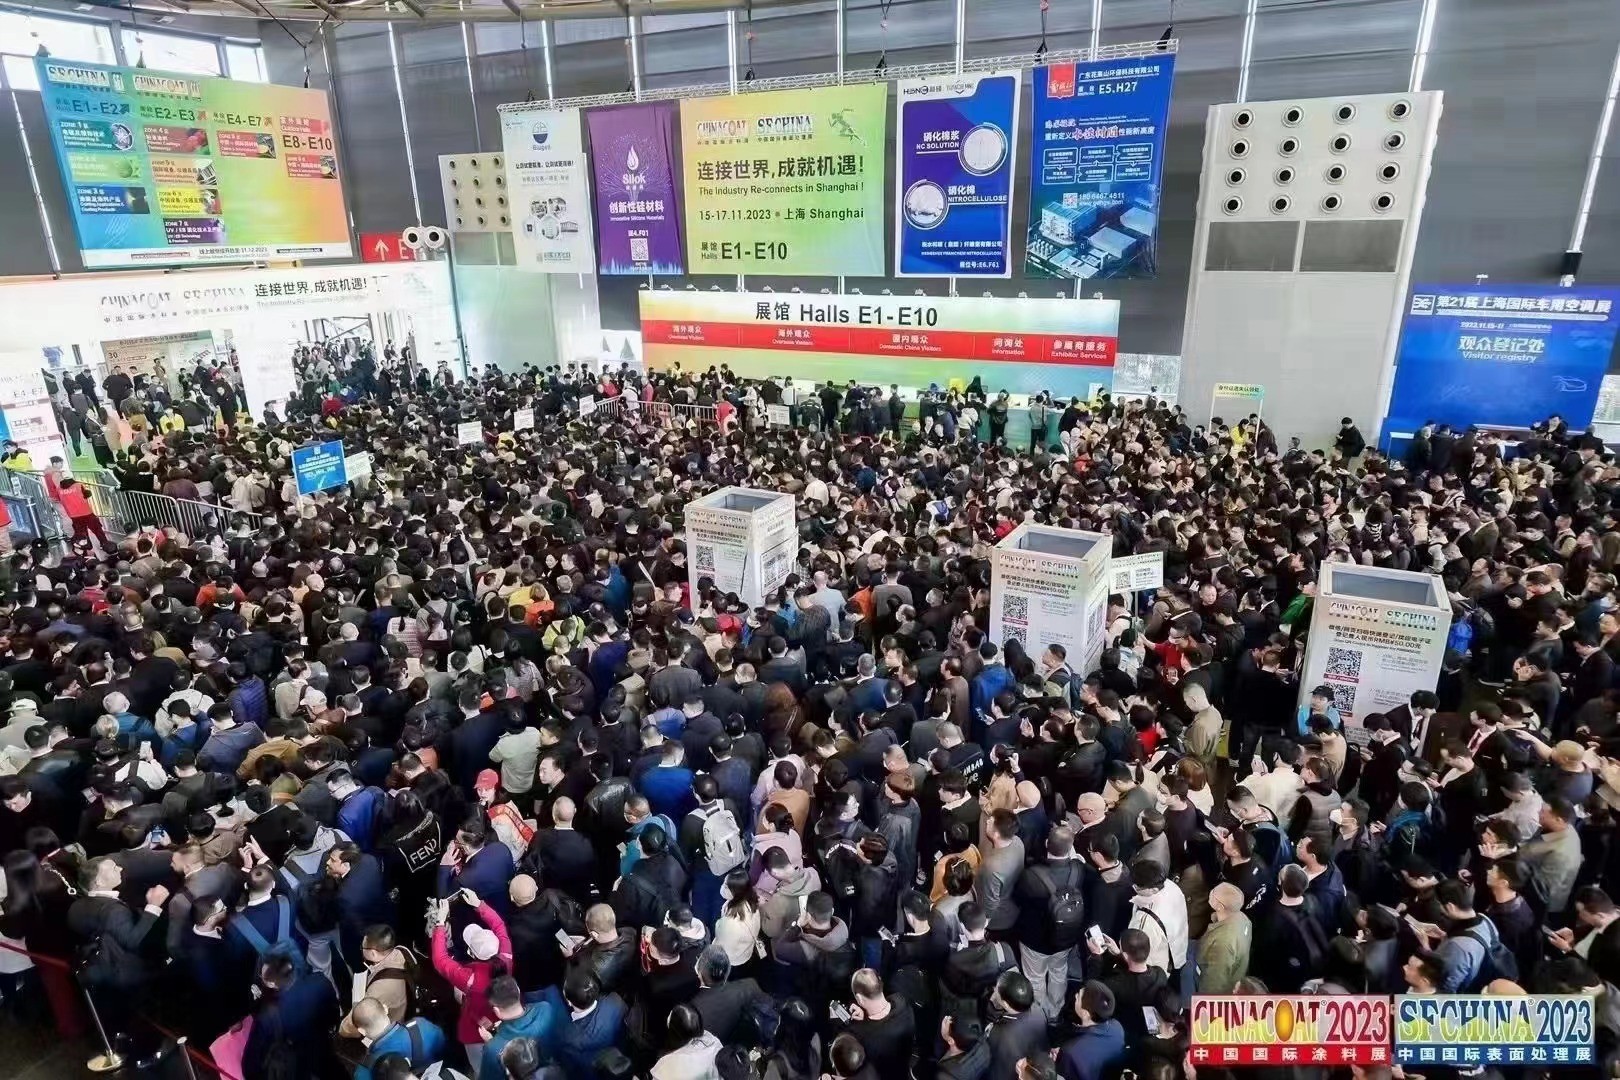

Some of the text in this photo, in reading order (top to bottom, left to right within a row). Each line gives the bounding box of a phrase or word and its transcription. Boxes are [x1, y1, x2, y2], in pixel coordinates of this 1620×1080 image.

[1099, 81, 1138, 95] E5.H27
[757, 115, 811, 134] SFCHINA
[927, 141, 960, 149] SOLUTION
[699, 186, 713, 196] The
[715, 185, 748, 197] Industry
[750, 183, 804, 194] Re-connects
[805, 183, 814, 192] in
[816, 181, 859, 194] Shanghai
[699, 209, 772, 221] 15-17.11.2023
[784, 207, 864, 221] 上海 Shanghai
[701, 242, 718, 251] 展馆
[1436, 295, 1612, 314] 第21届上海国际车用空调展
[755, 302, 791, 321] 展馆
[800, 304, 850, 323] Halls
[1458, 336, 1545, 354] 观众登记处
[1080, 352, 1107, 360] Services
[1462, 351, 1537, 364] Visitor registry
